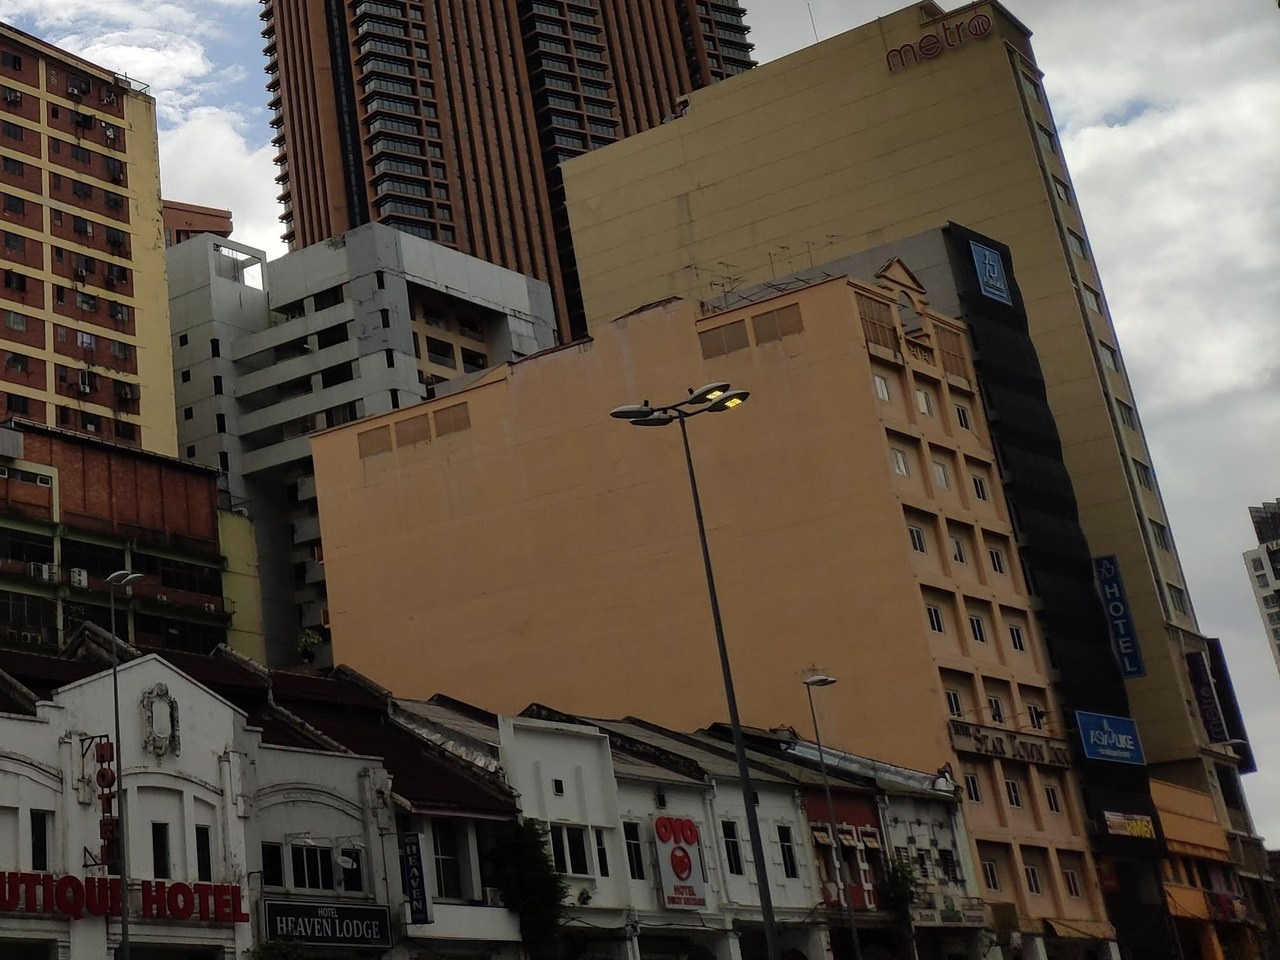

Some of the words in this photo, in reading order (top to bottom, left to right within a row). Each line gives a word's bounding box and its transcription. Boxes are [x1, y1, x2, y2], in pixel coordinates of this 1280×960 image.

[886, 14, 991, 72] metro
[1104, 583, 1138, 672] HOTEL
[655, 816, 698, 845] OYO
[406, 844, 424, 911] HEAVEN
[143, 880, 249, 923] HOTEL
[318, 907, 339, 918] HOTEL
[276, 916, 332, 938] HEAVEN
[336, 919, 381, 939] LODGE
